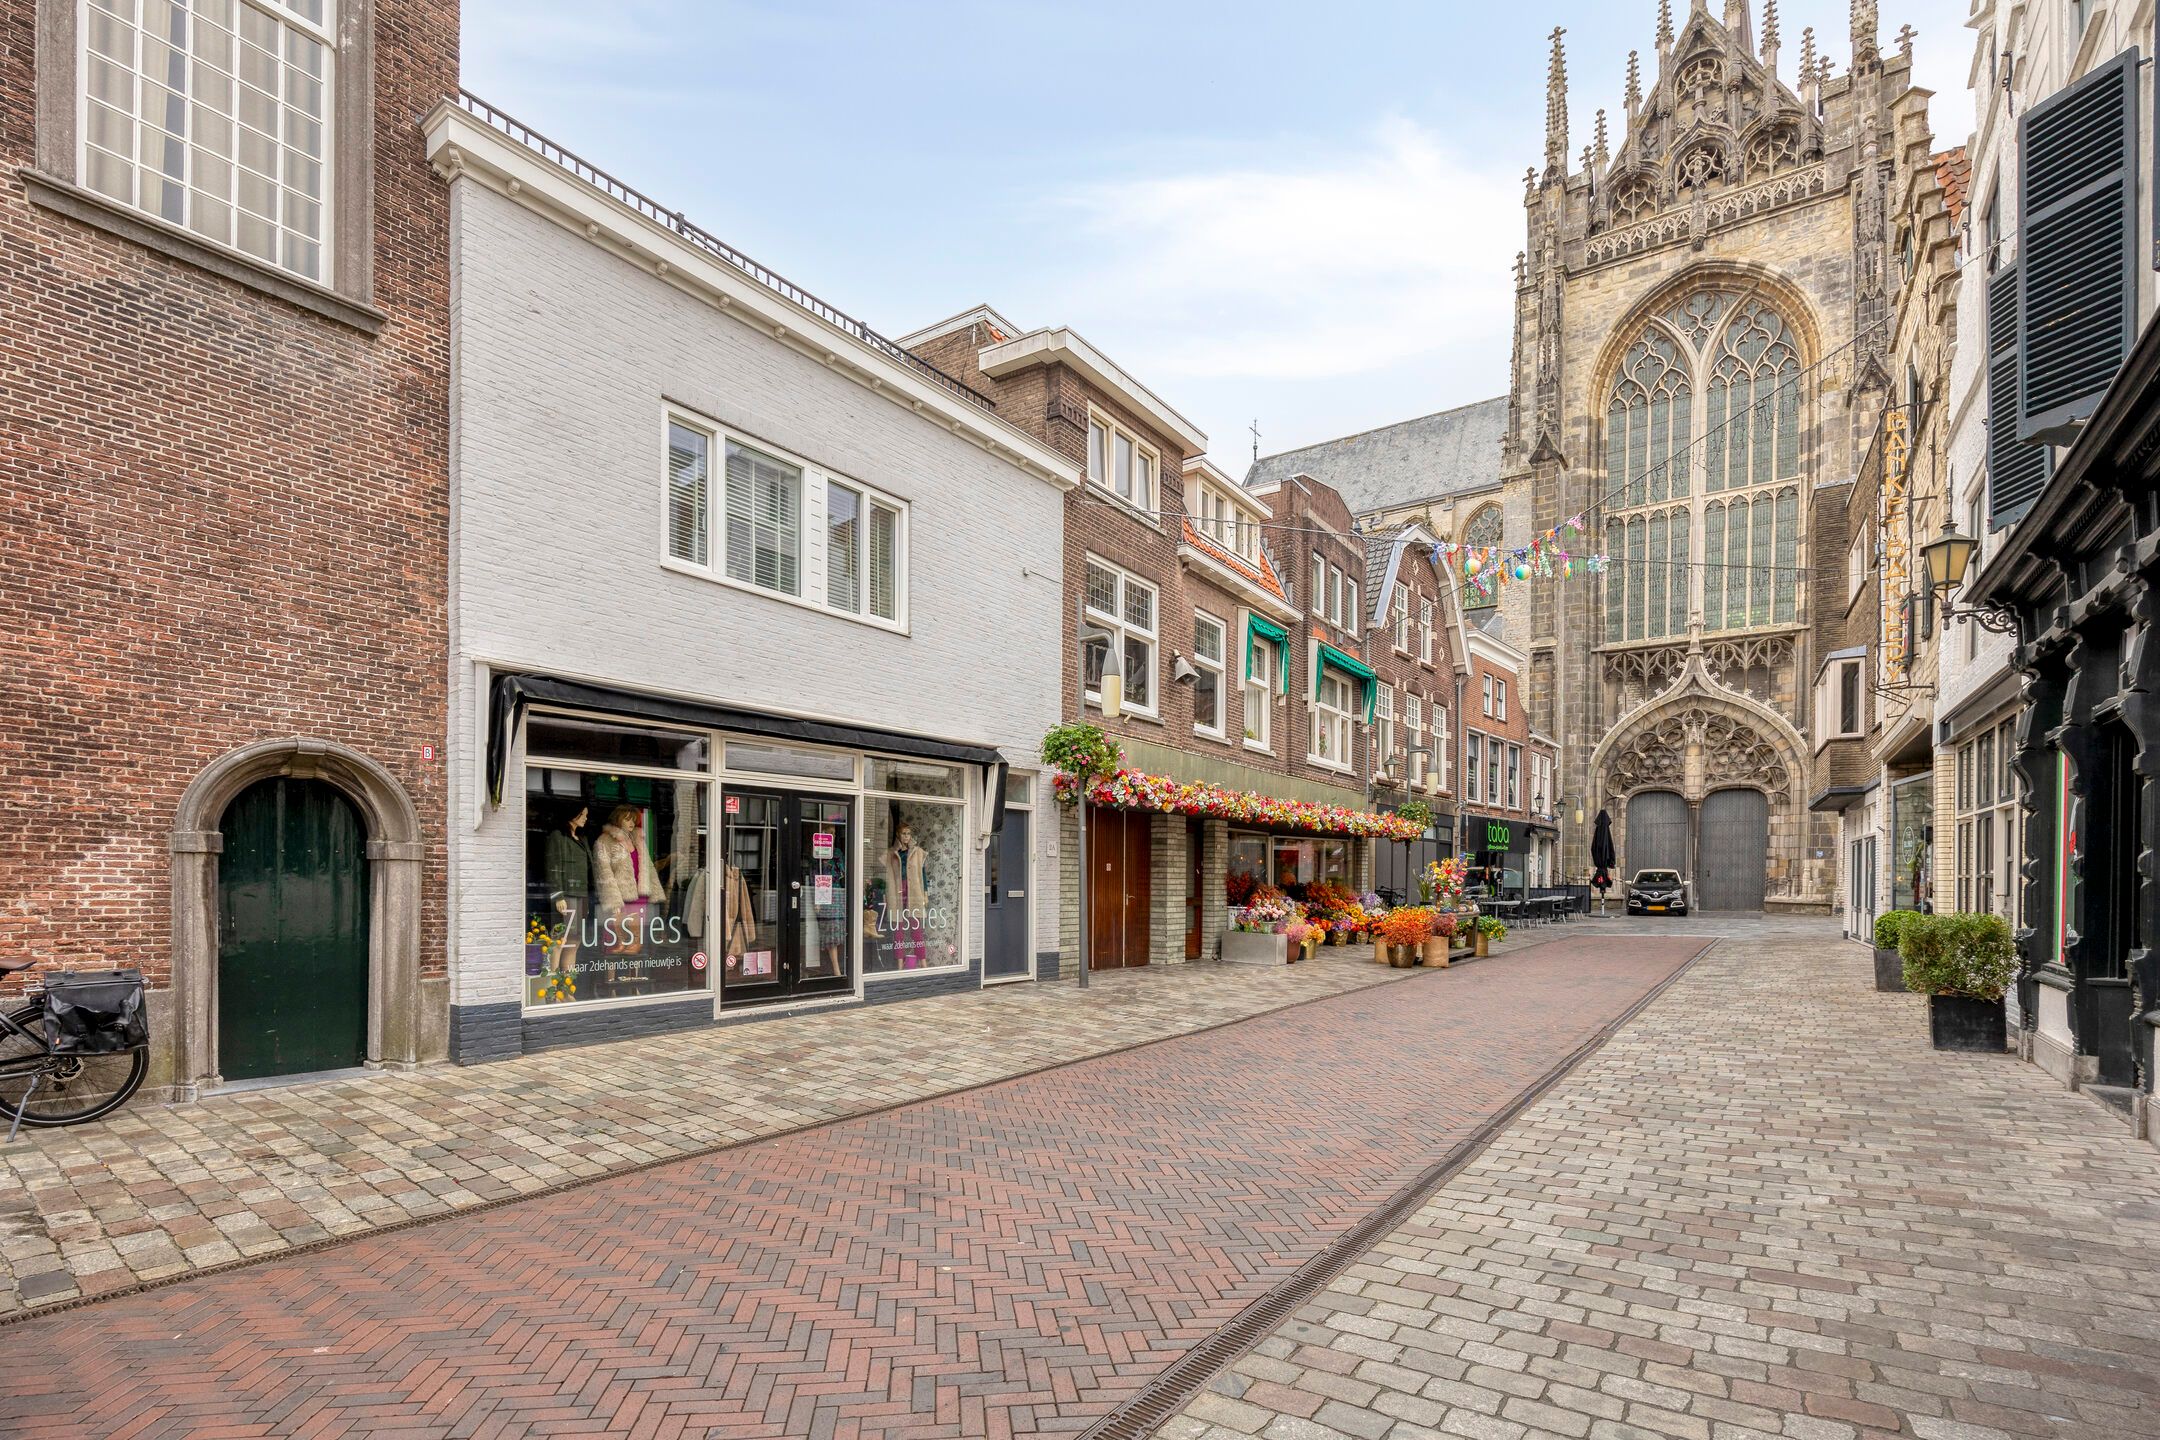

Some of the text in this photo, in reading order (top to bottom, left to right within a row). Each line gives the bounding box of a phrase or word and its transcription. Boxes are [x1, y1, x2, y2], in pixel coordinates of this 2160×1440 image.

[1488, 820, 1509, 843] taba
[561, 908, 681, 948] Zussies
[878, 902, 947, 932] Zussies
[567, 963, 588, 974] waar
[589, 958, 628, 972] 2dehands
[629, 960, 643, 969] een
[645, 957, 674, 969] nieuwtje
[676, 956, 682, 966] is
